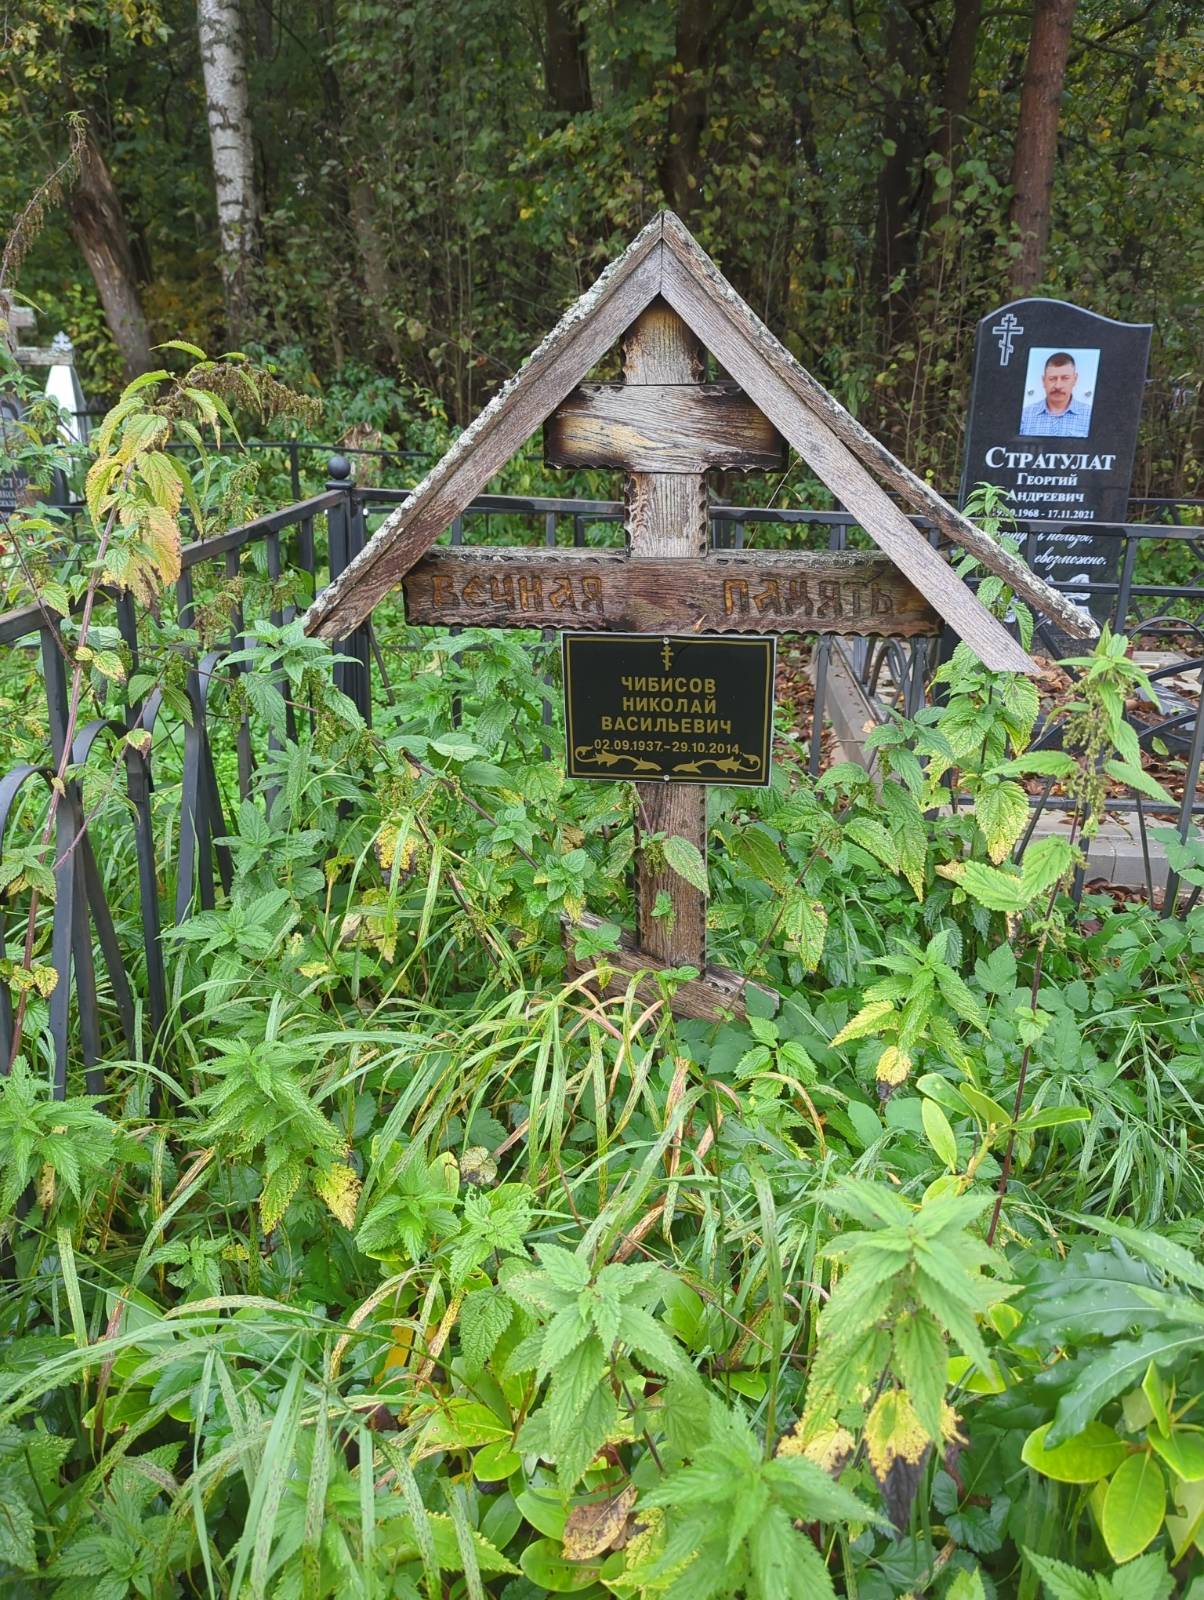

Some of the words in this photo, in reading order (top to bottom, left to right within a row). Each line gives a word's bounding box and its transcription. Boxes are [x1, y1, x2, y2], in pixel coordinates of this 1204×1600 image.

[1047, 509, 1095, 519] 17.11.2021
[1033, 546, 1107, 571] евозможно.
[621, 676, 716, 694] ЧИБИСОВ
[622, 695, 717, 714] НИКОЛАЙ
[601, 716, 732, 735] ВАСИЛЬЕВИЧ
